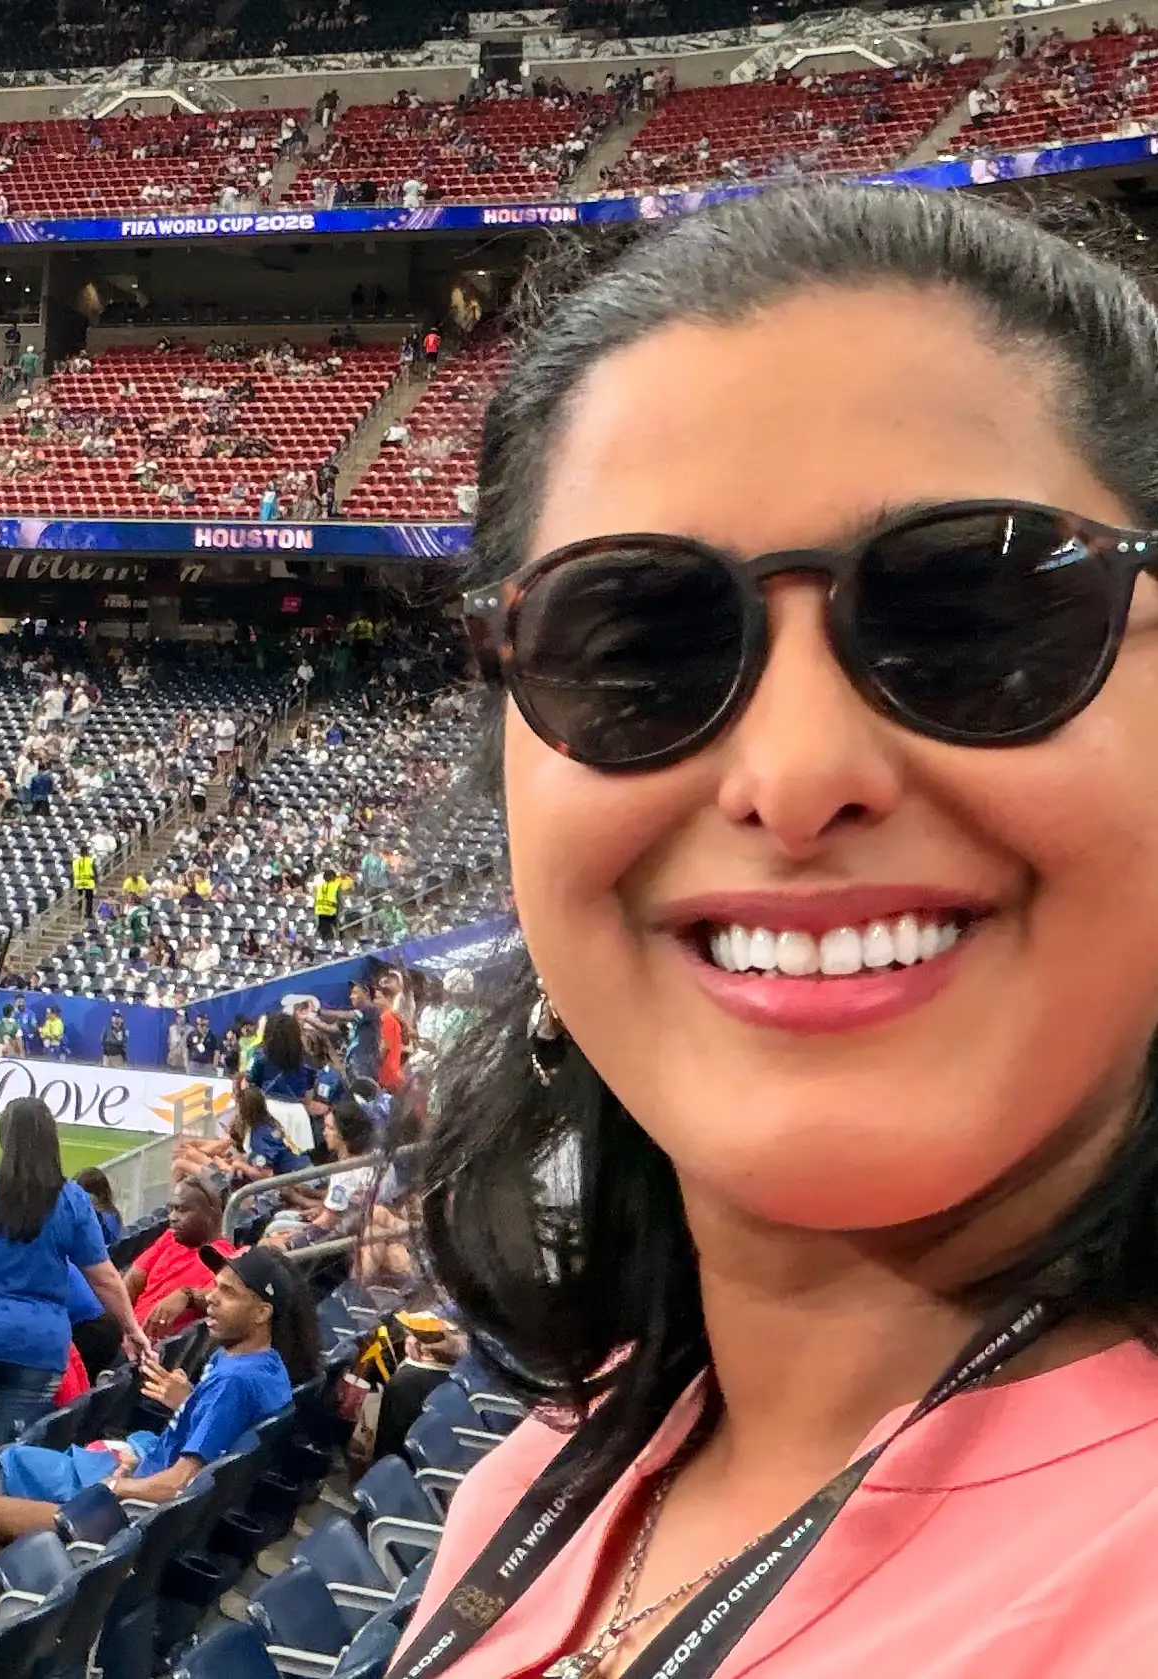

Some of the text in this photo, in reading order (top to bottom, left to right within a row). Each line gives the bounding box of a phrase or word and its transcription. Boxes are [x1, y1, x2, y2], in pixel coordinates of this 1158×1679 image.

[121, 214, 315, 236] FIFA WORLD CUP 2026
[483, 207, 577, 224] HOUSTON
[194, 528, 313, 549] HOUSTON
[497, 1497, 566, 1577] FIFA WORLD
[780, 1518, 814, 1548] FIFA
[728, 1551, 782, 1602] WORLD
[700, 1601, 730, 1635] CUP
